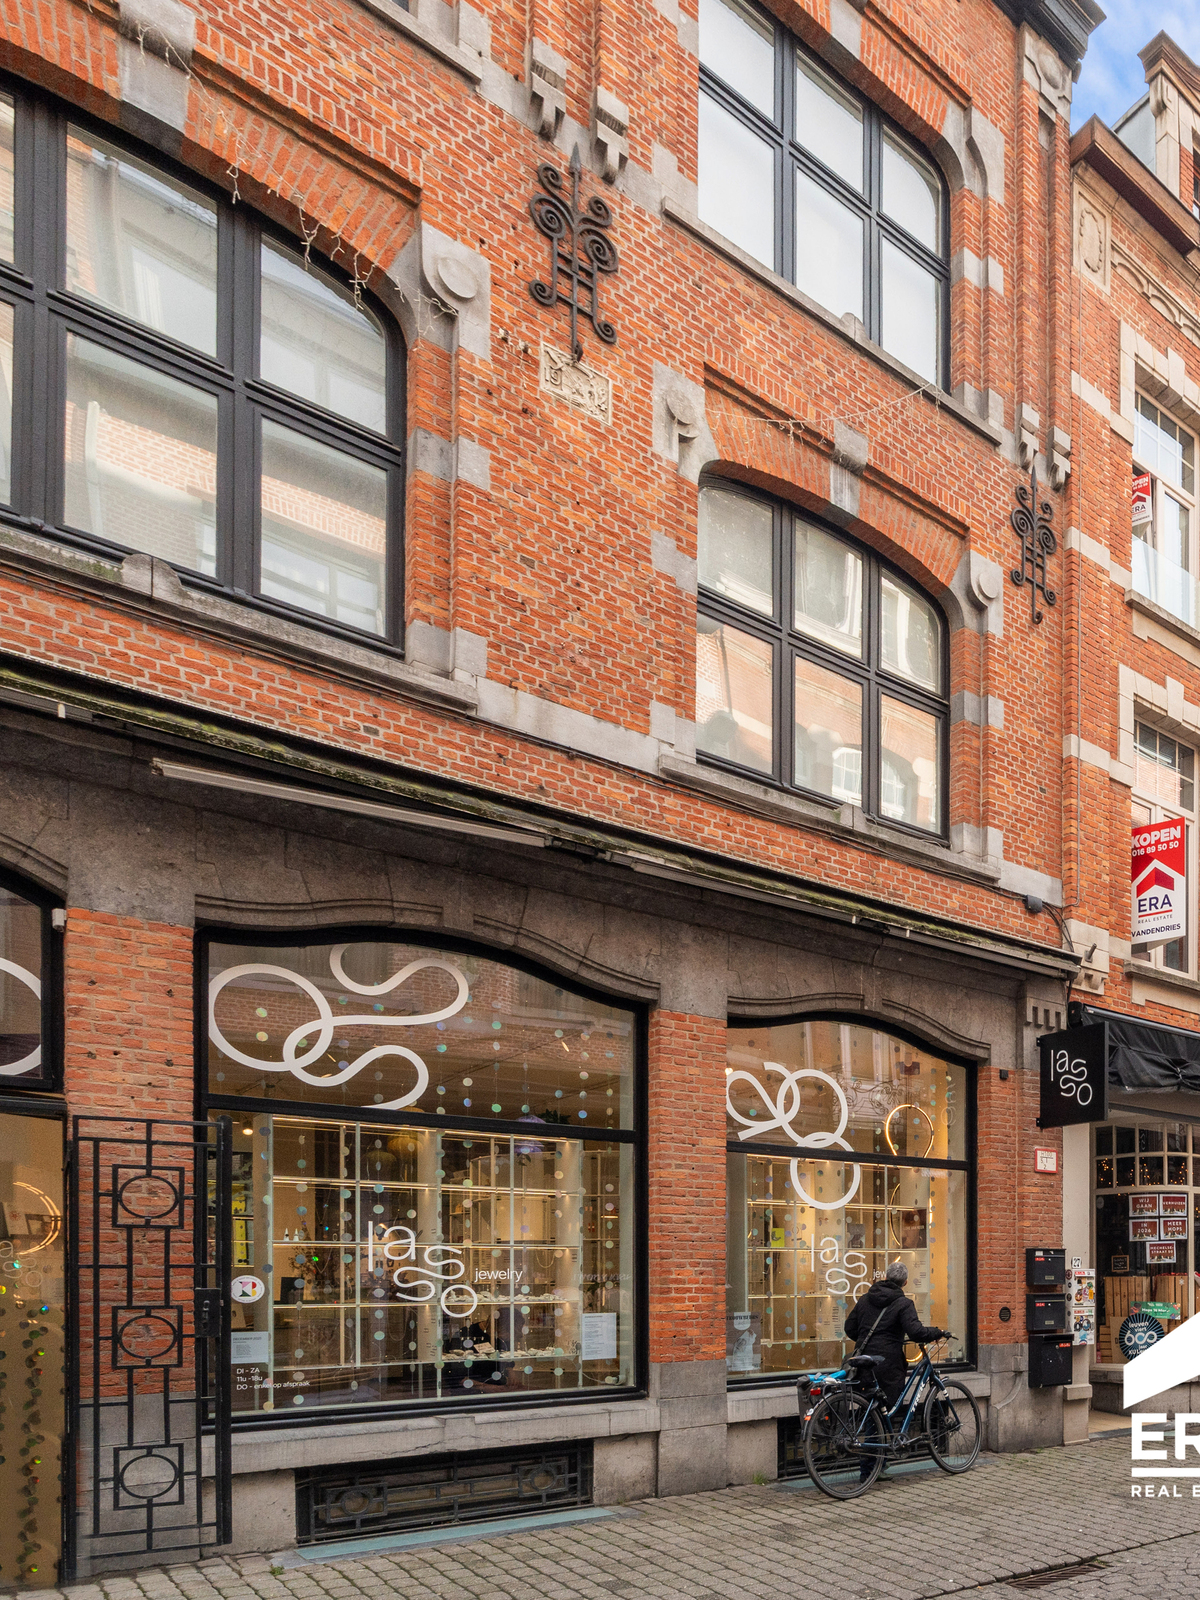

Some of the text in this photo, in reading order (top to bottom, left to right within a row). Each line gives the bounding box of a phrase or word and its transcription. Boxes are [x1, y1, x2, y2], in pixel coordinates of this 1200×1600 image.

[1131, 476, 1149, 487] OPEN
[1131, 825, 1181, 849] KOPEN
[1131, 840, 1179, 857] 016 89 50 50
[1138, 893, 1173, 913] ERA
[1131, 923, 1181, 938] VANDENDRIES
[1073, 1256, 1081, 1268] 27
[474, 1268, 523, 1283] jewelry
[283, 1380, 311, 1388] afspraak
